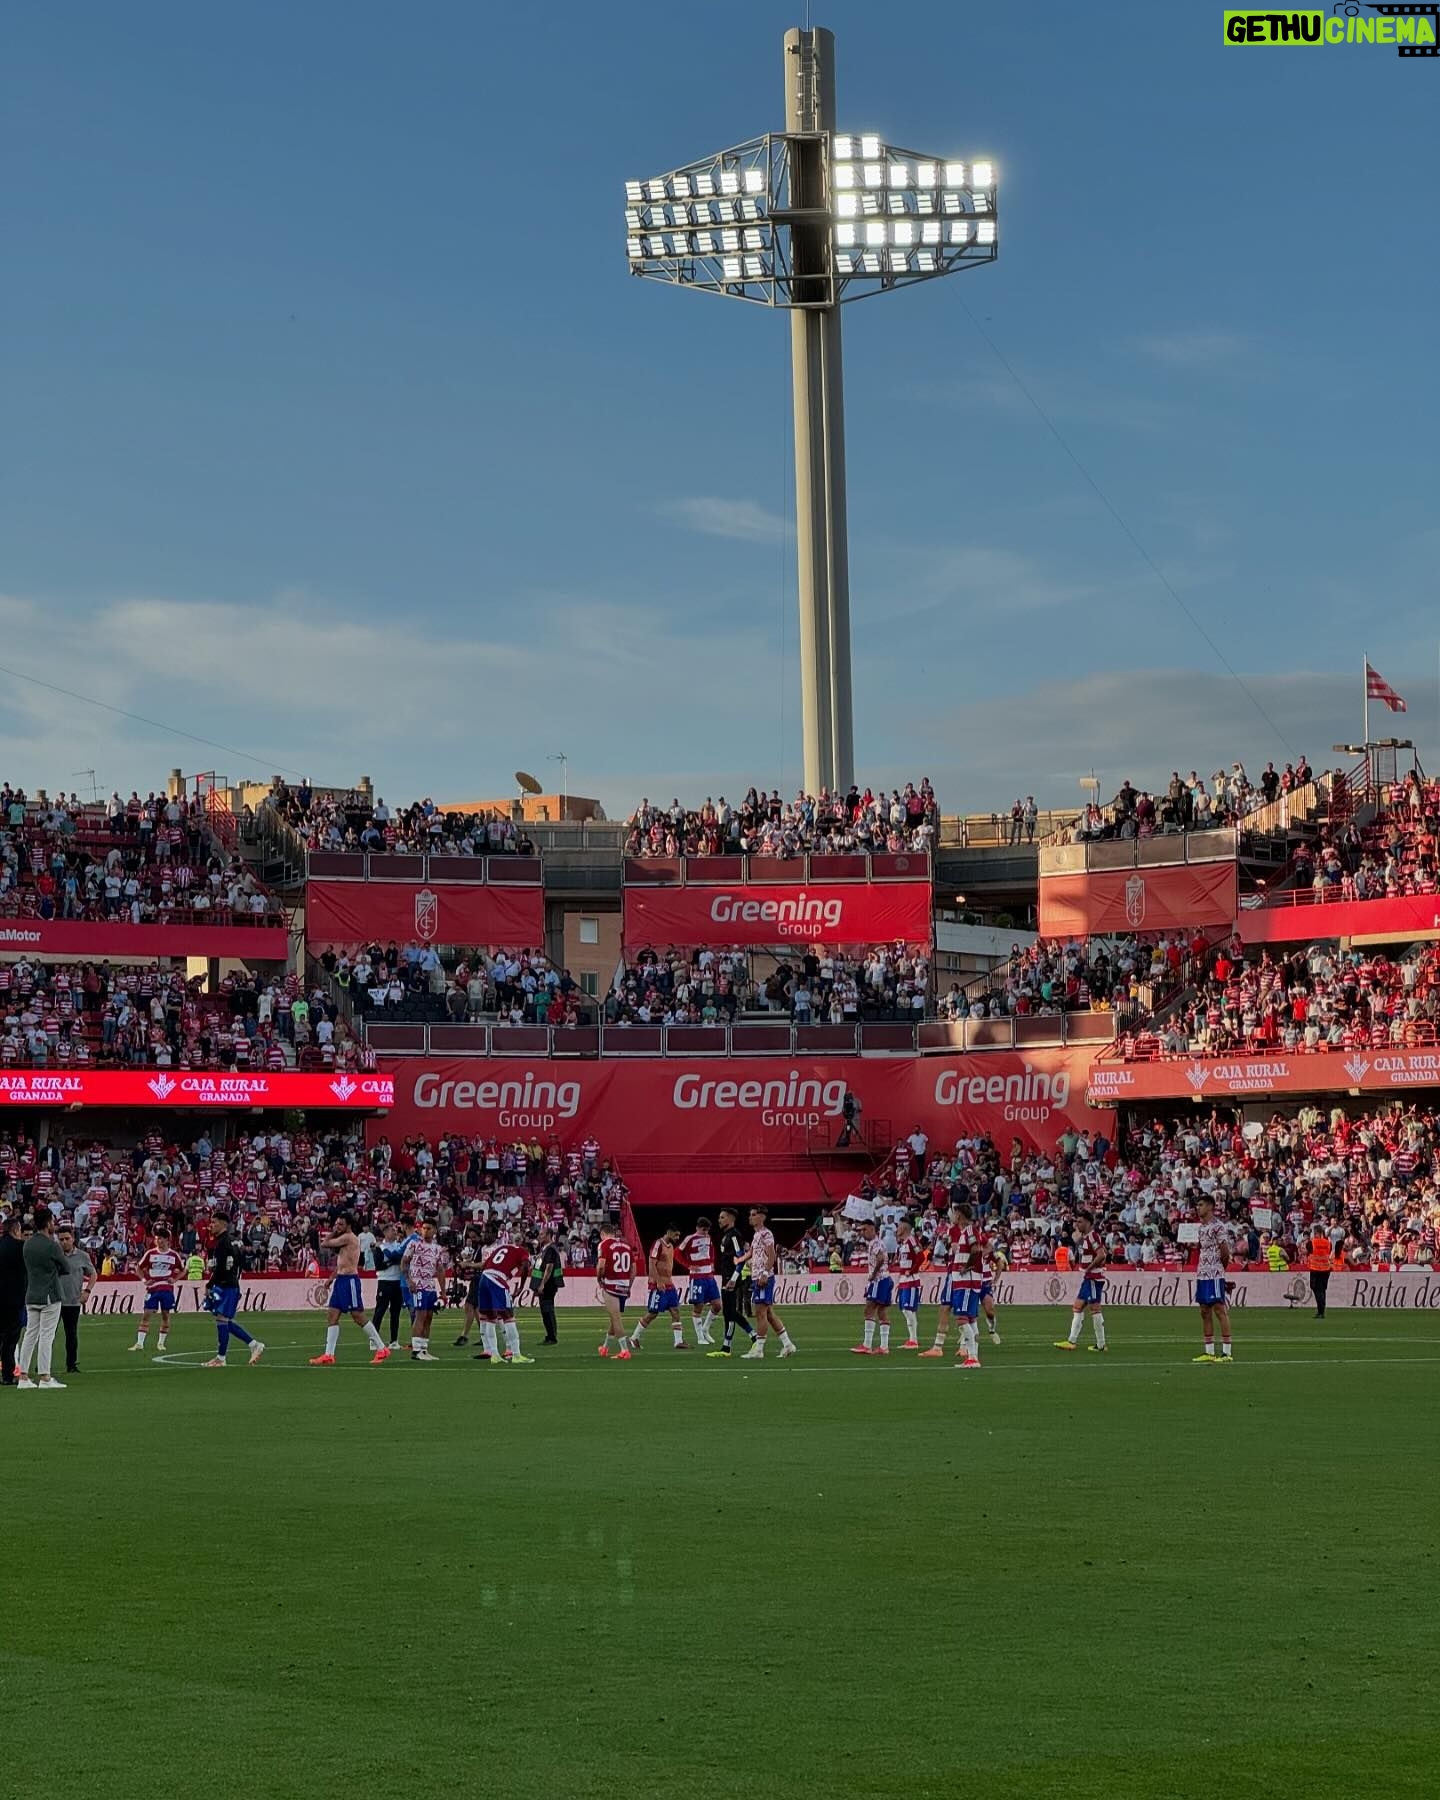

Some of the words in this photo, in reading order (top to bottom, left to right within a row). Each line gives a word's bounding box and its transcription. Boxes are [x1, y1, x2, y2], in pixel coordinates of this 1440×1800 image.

[710, 893, 843, 927] Greening
[778, 922, 822, 937] Group
[1213, 1064, 1243, 1079] CAJA
[1246, 1062, 1290, 1077] RURAL
[1373, 1056, 1406, 1071] CAJA
[0, 1077, 27, 1090] AJA
[31, 1077, 84, 1091] RURAL
[181, 1078, 216, 1092] CAJA
[220, 1079, 269, 1092] RURAL
[1094, 1071, 1135, 1085] RURAL
[1229, 1079, 1274, 1090] GRANADA
[1391, 1070, 1440, 1082] GRANADA
[361, 1080, 394, 1093] CAJA
[413, 1072, 581, 1118] Greening
[673, 1070, 847, 1116] Greening
[935, 1064, 1071, 1109] Greening
[9, 1091, 64, 1101] GRANADA
[199, 1092, 251, 1102] GRANADA
[499, 1110, 554, 1131] Group
[762, 1109, 819, 1129] Group
[1004, 1104, 1049, 1124] Group
[492, 1248, 508, 1265] 6
[612, 1251, 631, 1273] 20
[772, 1278, 809, 1304] eleta
[1149, 1276, 1180, 1306] del
[1351, 1278, 1407, 1308] Ruta
[81, 1289, 135, 1315] uta
